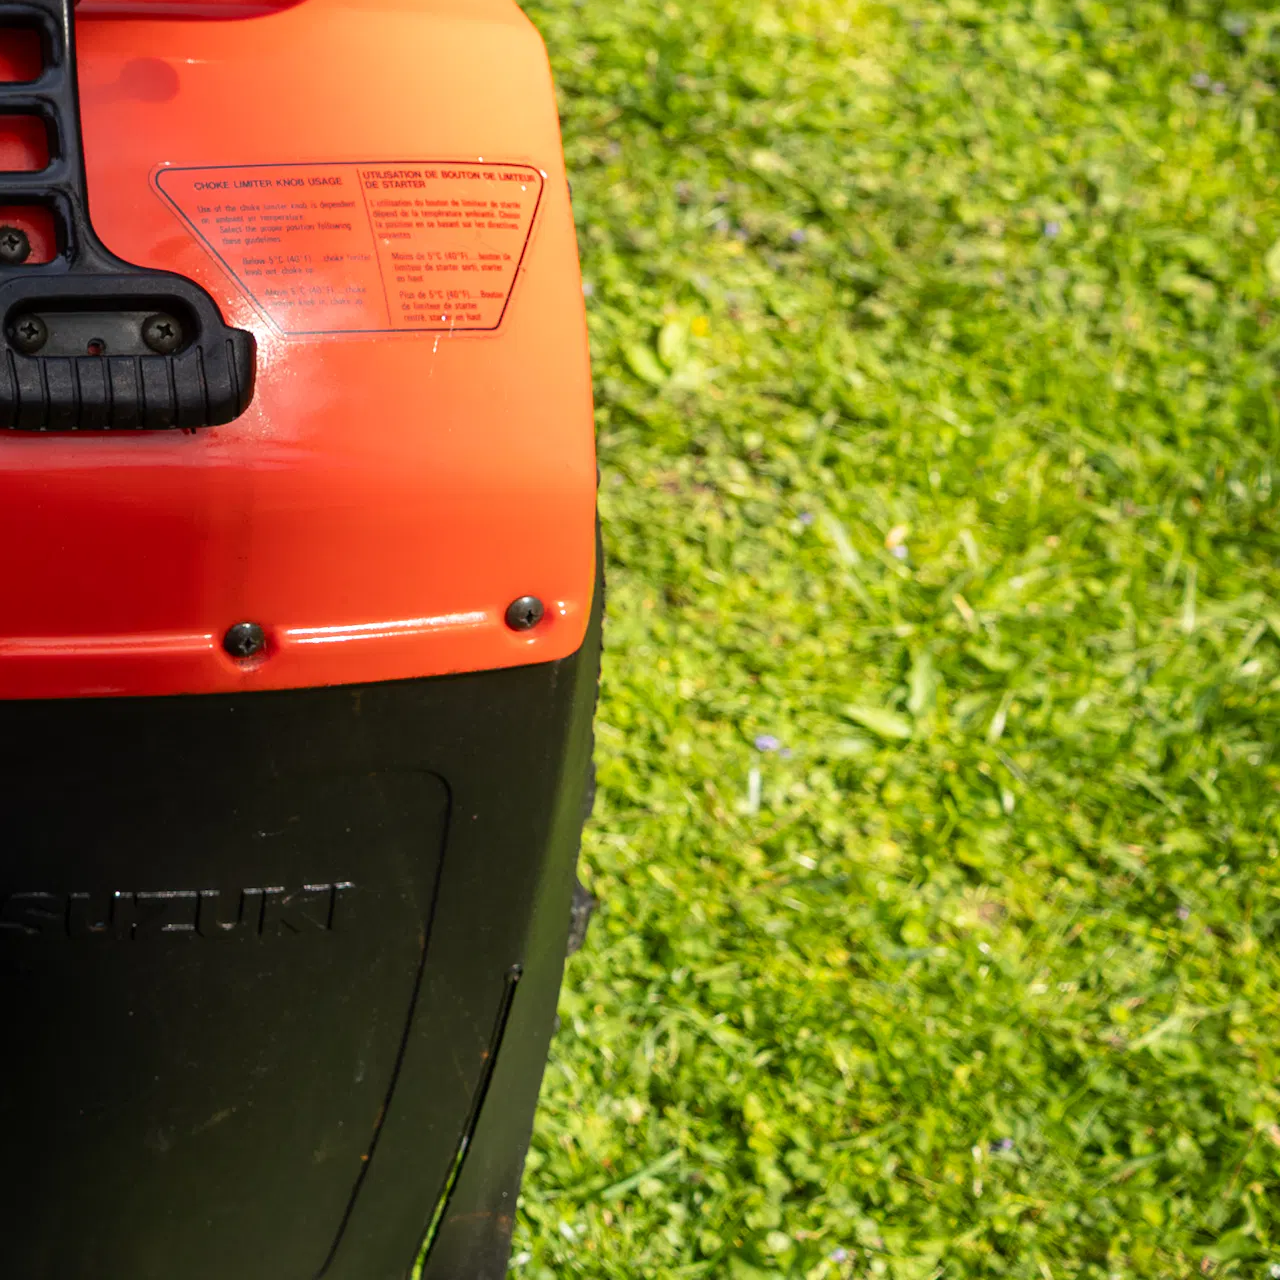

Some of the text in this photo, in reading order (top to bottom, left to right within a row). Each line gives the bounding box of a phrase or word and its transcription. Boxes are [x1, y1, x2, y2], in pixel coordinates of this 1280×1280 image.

[362, 171, 422, 180] UTILISATION
[424, 171, 438, 180] DE
[441, 171, 481, 180] BOUTON
[482, 172, 496, 181] DE
[193, 177, 343, 191] CHOKE LIMITER KNOB USAGE
[365, 180, 427, 189] DE STARTER
